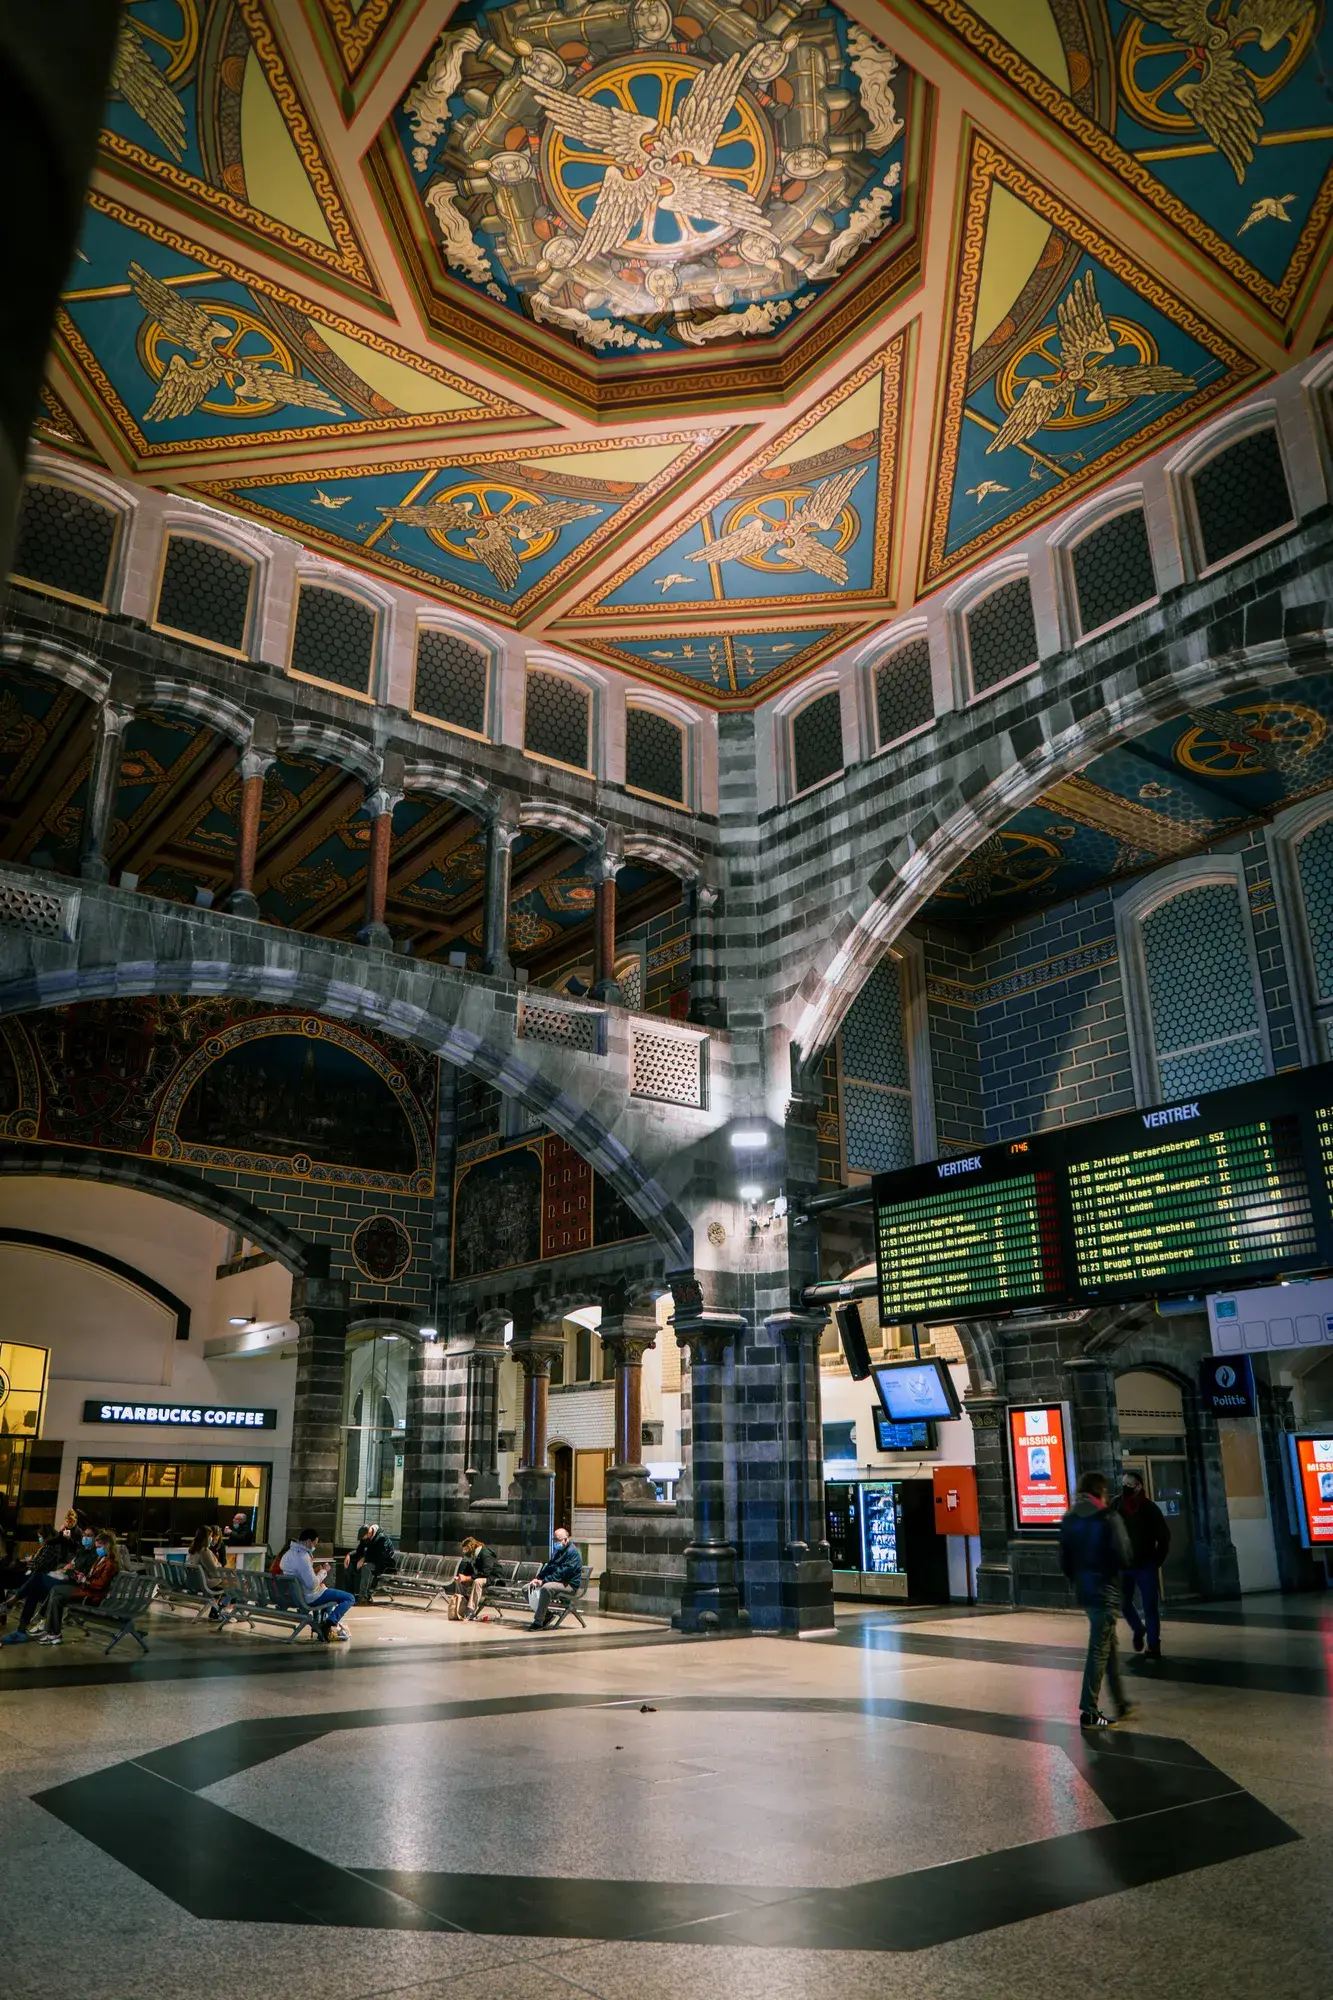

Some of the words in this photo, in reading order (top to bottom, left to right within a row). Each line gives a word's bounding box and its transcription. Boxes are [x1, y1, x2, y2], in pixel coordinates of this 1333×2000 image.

[1142, 1102, 1200, 1128] VERTREK
[1068, 1161, 1089, 1173] 18:05
[1093, 1152, 1129, 1168] Zottegem
[1132, 1137, 1200, 1159] Geraardsbergen
[1259, 1123, 1266, 1132] 6
[1069, 1173, 1090, 1186] 18:09
[1094, 1165, 1131, 1180] Kortrijk
[1216, 1144, 1228, 1155] IC
[1257, 1136, 1267, 1147] 11
[937, 1156, 982, 1178] VERTREK
[1070, 1186, 1092, 1198] 18:10
[1095, 1179, 1123, 1193] Brugge
[1126, 1171, 1164, 1187] Oostende
[1218, 1158, 1230, 1168] IC
[1263, 1150, 1270, 1159] 2
[1071, 1198, 1093, 1210] 18:11
[1096, 1186, 1152, 1205] Sint-Niklaas
[1155, 1175, 1210, 1194] Antwerpen-C
[1220, 1171, 1231, 1182] IC
[1265, 1163, 1272, 1173] 3
[1024, 1198, 1033, 1208] 11
[1072, 1211, 1094, 1223] 18:12
[1125, 1199, 1153, 1213] Landen
[1221, 1184, 1233, 1195] IC
[994, 1217, 1002, 1226] IC
[1074, 1223, 1096, 1235] 18:15
[1099, 1218, 1123, 1231] Eeklo
[1075, 1236, 1096, 1248] 18:21
[1100, 1226, 1152, 1244] Dendermonde
[1155, 1219, 1195, 1234] Mechelen
[1229, 1211, 1235, 1221] L
[900, 1240, 943, 1255] Sint-Niklaas
[994, 1228, 1003, 1238] IC
[1030, 1222, 1035, 1231] 4
[1076, 1249, 1098, 1261] 18:22
[1102, 1243, 1130, 1256] Aalter
[1133, 1238, 1163, 1251] Brugge
[1231, 1225, 1237, 1235] P
[1077, 1261, 1100, 1273] 18:23
[1103, 1256, 1131, 1269] Brugge
[1134, 1246, 1193, 1264] Blankenberge
[1228, 1238, 1240, 1249] IC
[1270, 1232, 1282, 1242] 12
[901, 1254, 925, 1266] Brussel
[995, 1240, 1004, 1250] IC
[1078, 1274, 1101, 1286] 18:24
[1104, 1269, 1137, 1282] Brussel
[1141, 1264, 1166, 1277] Eupen
[1230, 1252, 1242, 1263] IC
[1272, 1246, 1283, 1256] 11
[902, 1275, 941, 1288] Dendermonde
[945, 1270, 968, 1282] Leuven
[997, 1264, 1006, 1274] IC
[1033, 1259, 1038, 1268] 2
[902, 1289, 927, 1300] Brussel
[998, 1276, 1007, 1286] IC
[903, 1301, 925, 1311] Brugge
[928, 1297, 951, 1308] Knokke
[999, 1289, 1008, 1298] IC
[1032, 1284, 1040, 1293] 12
[1212, 1394, 1246, 1406] Politie
[100, 1406, 202, 1422] STARBUCKS
[204, 1410, 264, 1424] COFFEE
[1018, 1435, 1058, 1446] MISSING
